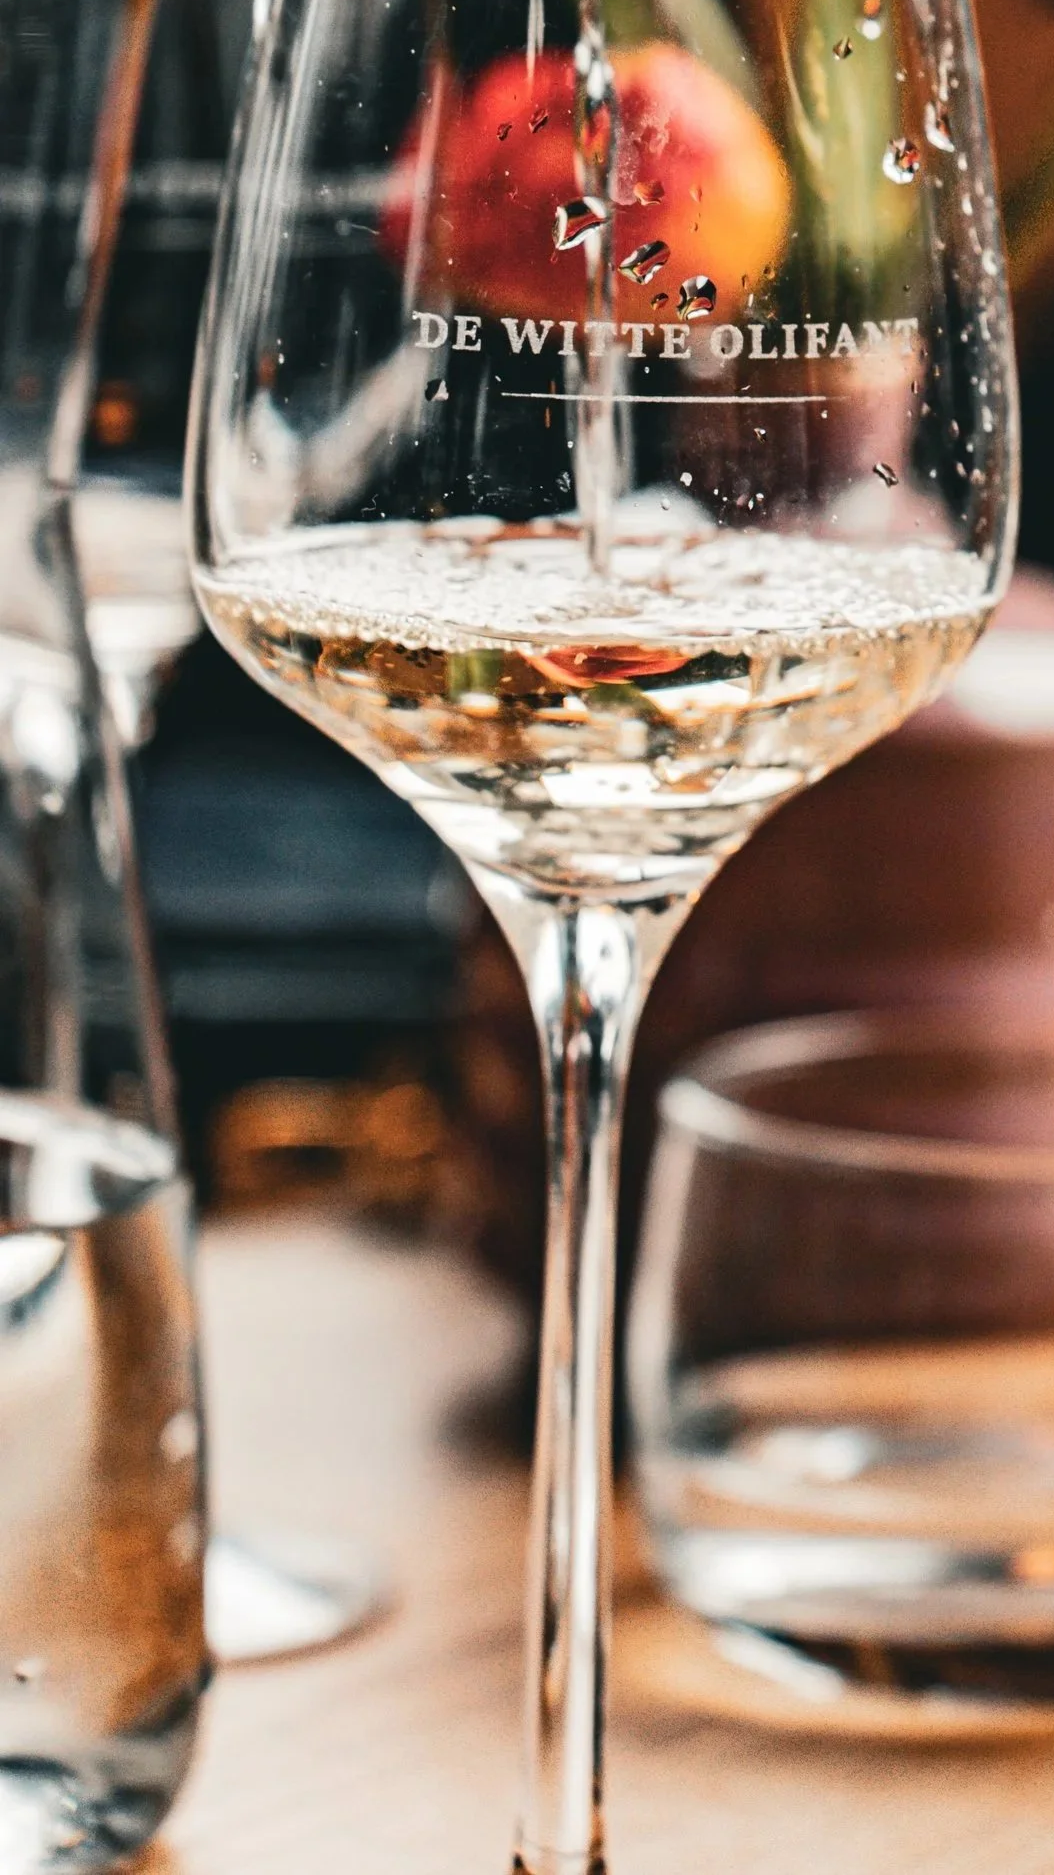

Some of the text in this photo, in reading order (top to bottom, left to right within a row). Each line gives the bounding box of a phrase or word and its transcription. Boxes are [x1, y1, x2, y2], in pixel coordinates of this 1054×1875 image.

[412, 311, 919, 361] DE WITTE OLIFANT
